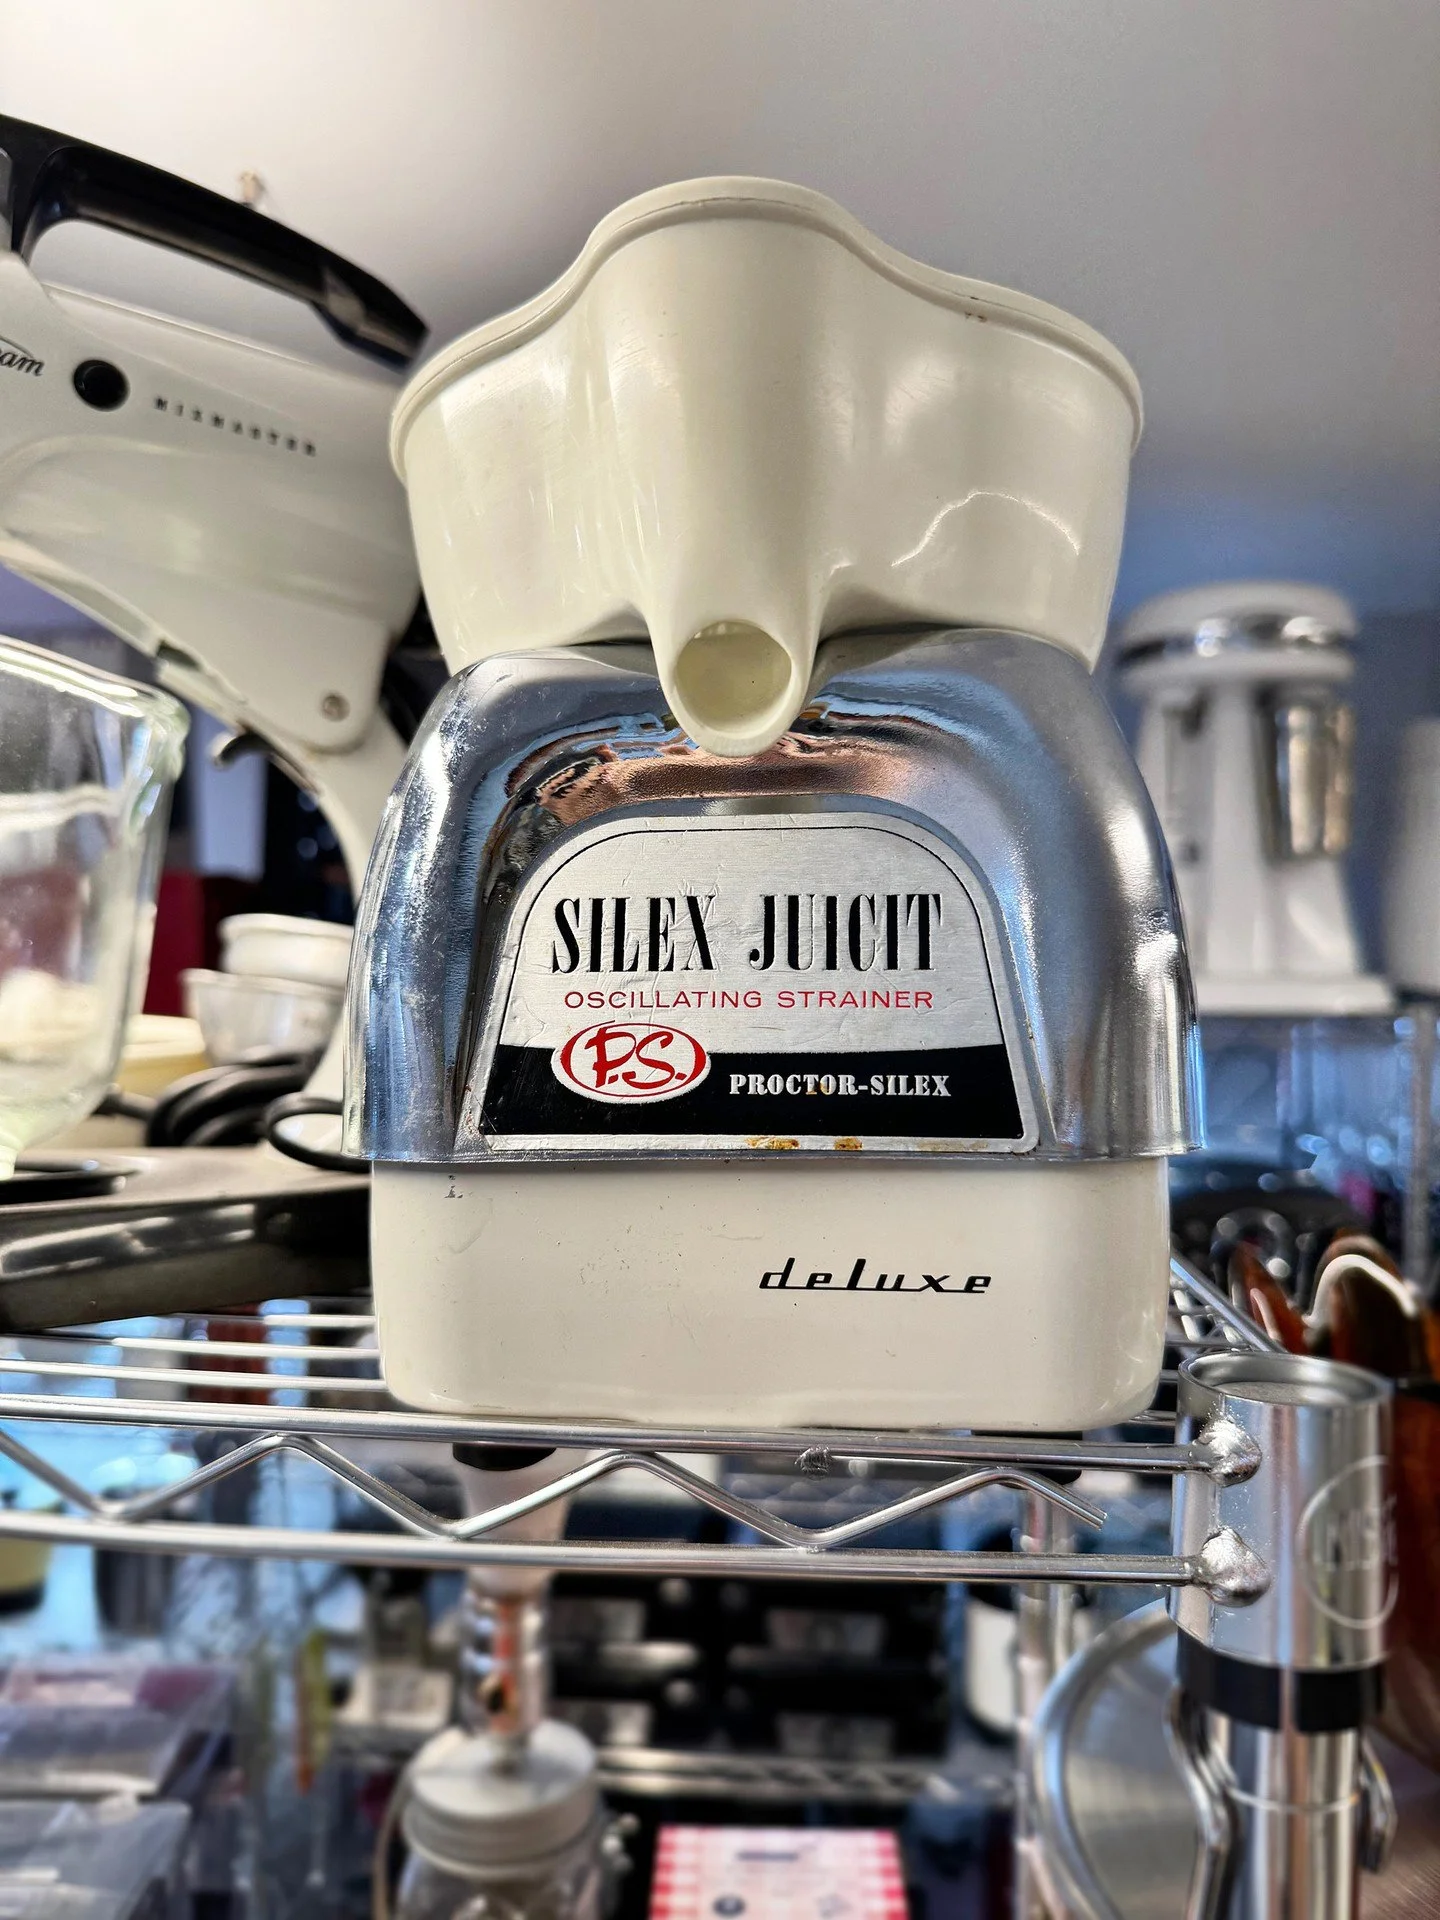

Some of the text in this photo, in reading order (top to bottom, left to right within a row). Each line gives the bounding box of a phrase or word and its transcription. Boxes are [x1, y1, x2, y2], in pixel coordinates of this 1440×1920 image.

[0, 349, 45, 377] am
[552, 893, 942, 974] SILEX JUICIT
[564, 990, 934, 1009] OSCILLATING STRAINER
[729, 1073, 952, 1098] PROCTOR-SILEX
[759, 1257, 992, 1294] deluxe
